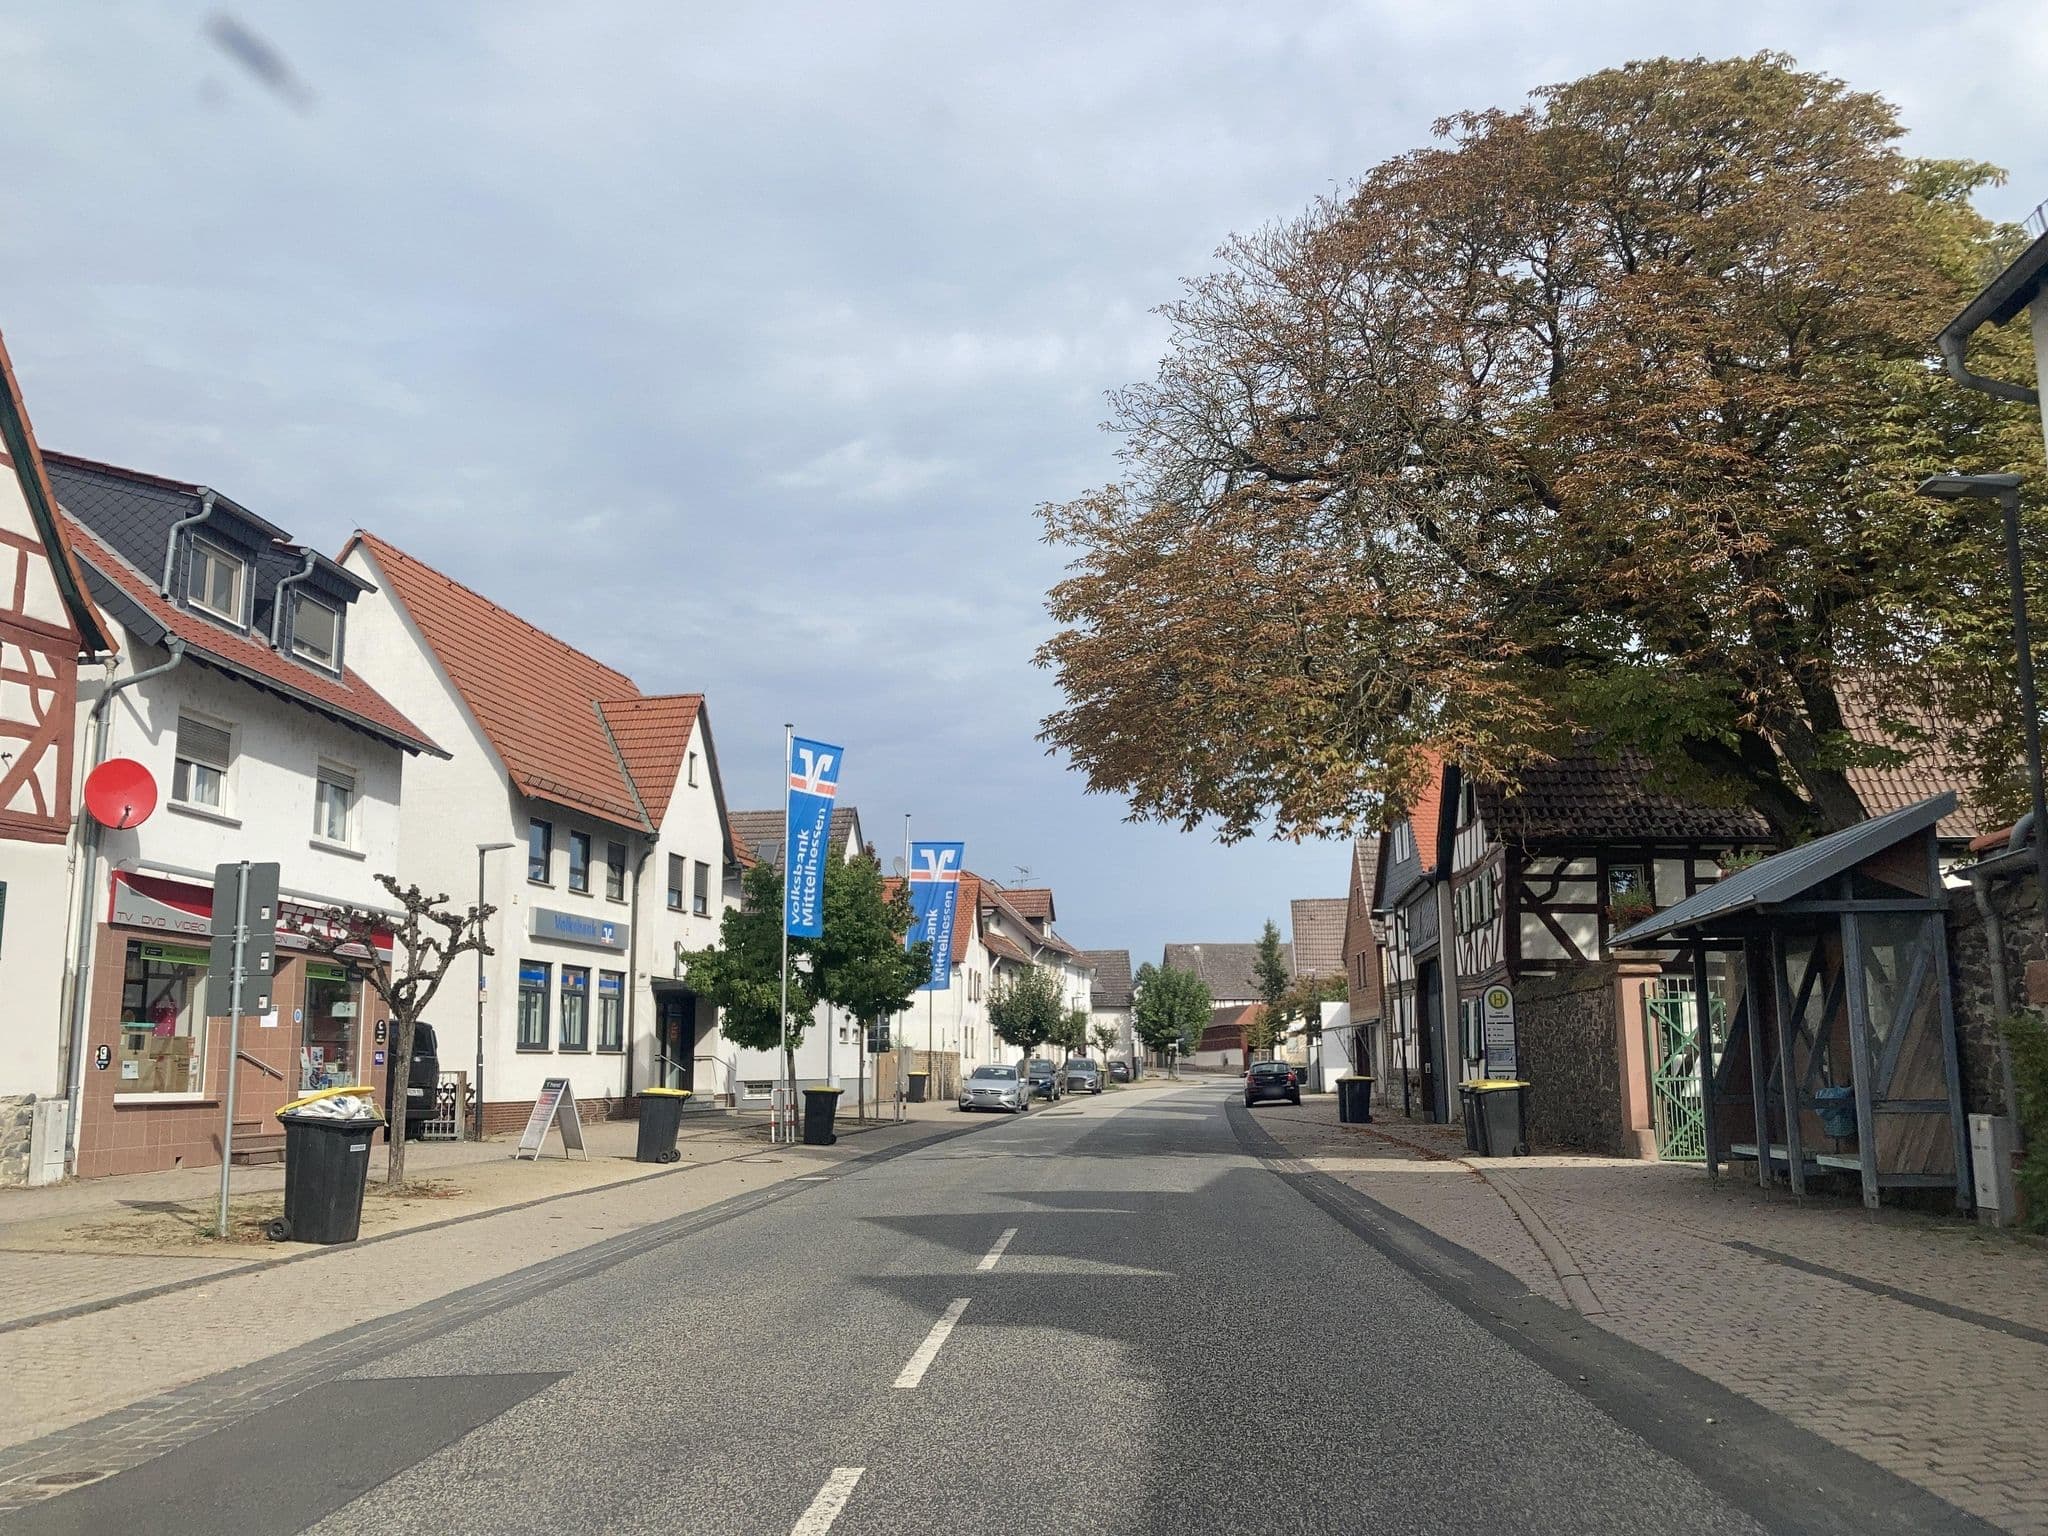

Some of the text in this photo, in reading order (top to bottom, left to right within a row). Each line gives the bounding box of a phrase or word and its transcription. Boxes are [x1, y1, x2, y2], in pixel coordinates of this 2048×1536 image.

[791, 828, 810, 926] Volksbank
[802, 808, 827, 927] Mittelhessen
[117, 911, 208, 933] TV DVD VIDEO
[934, 890, 954, 981] Mittelhessen
